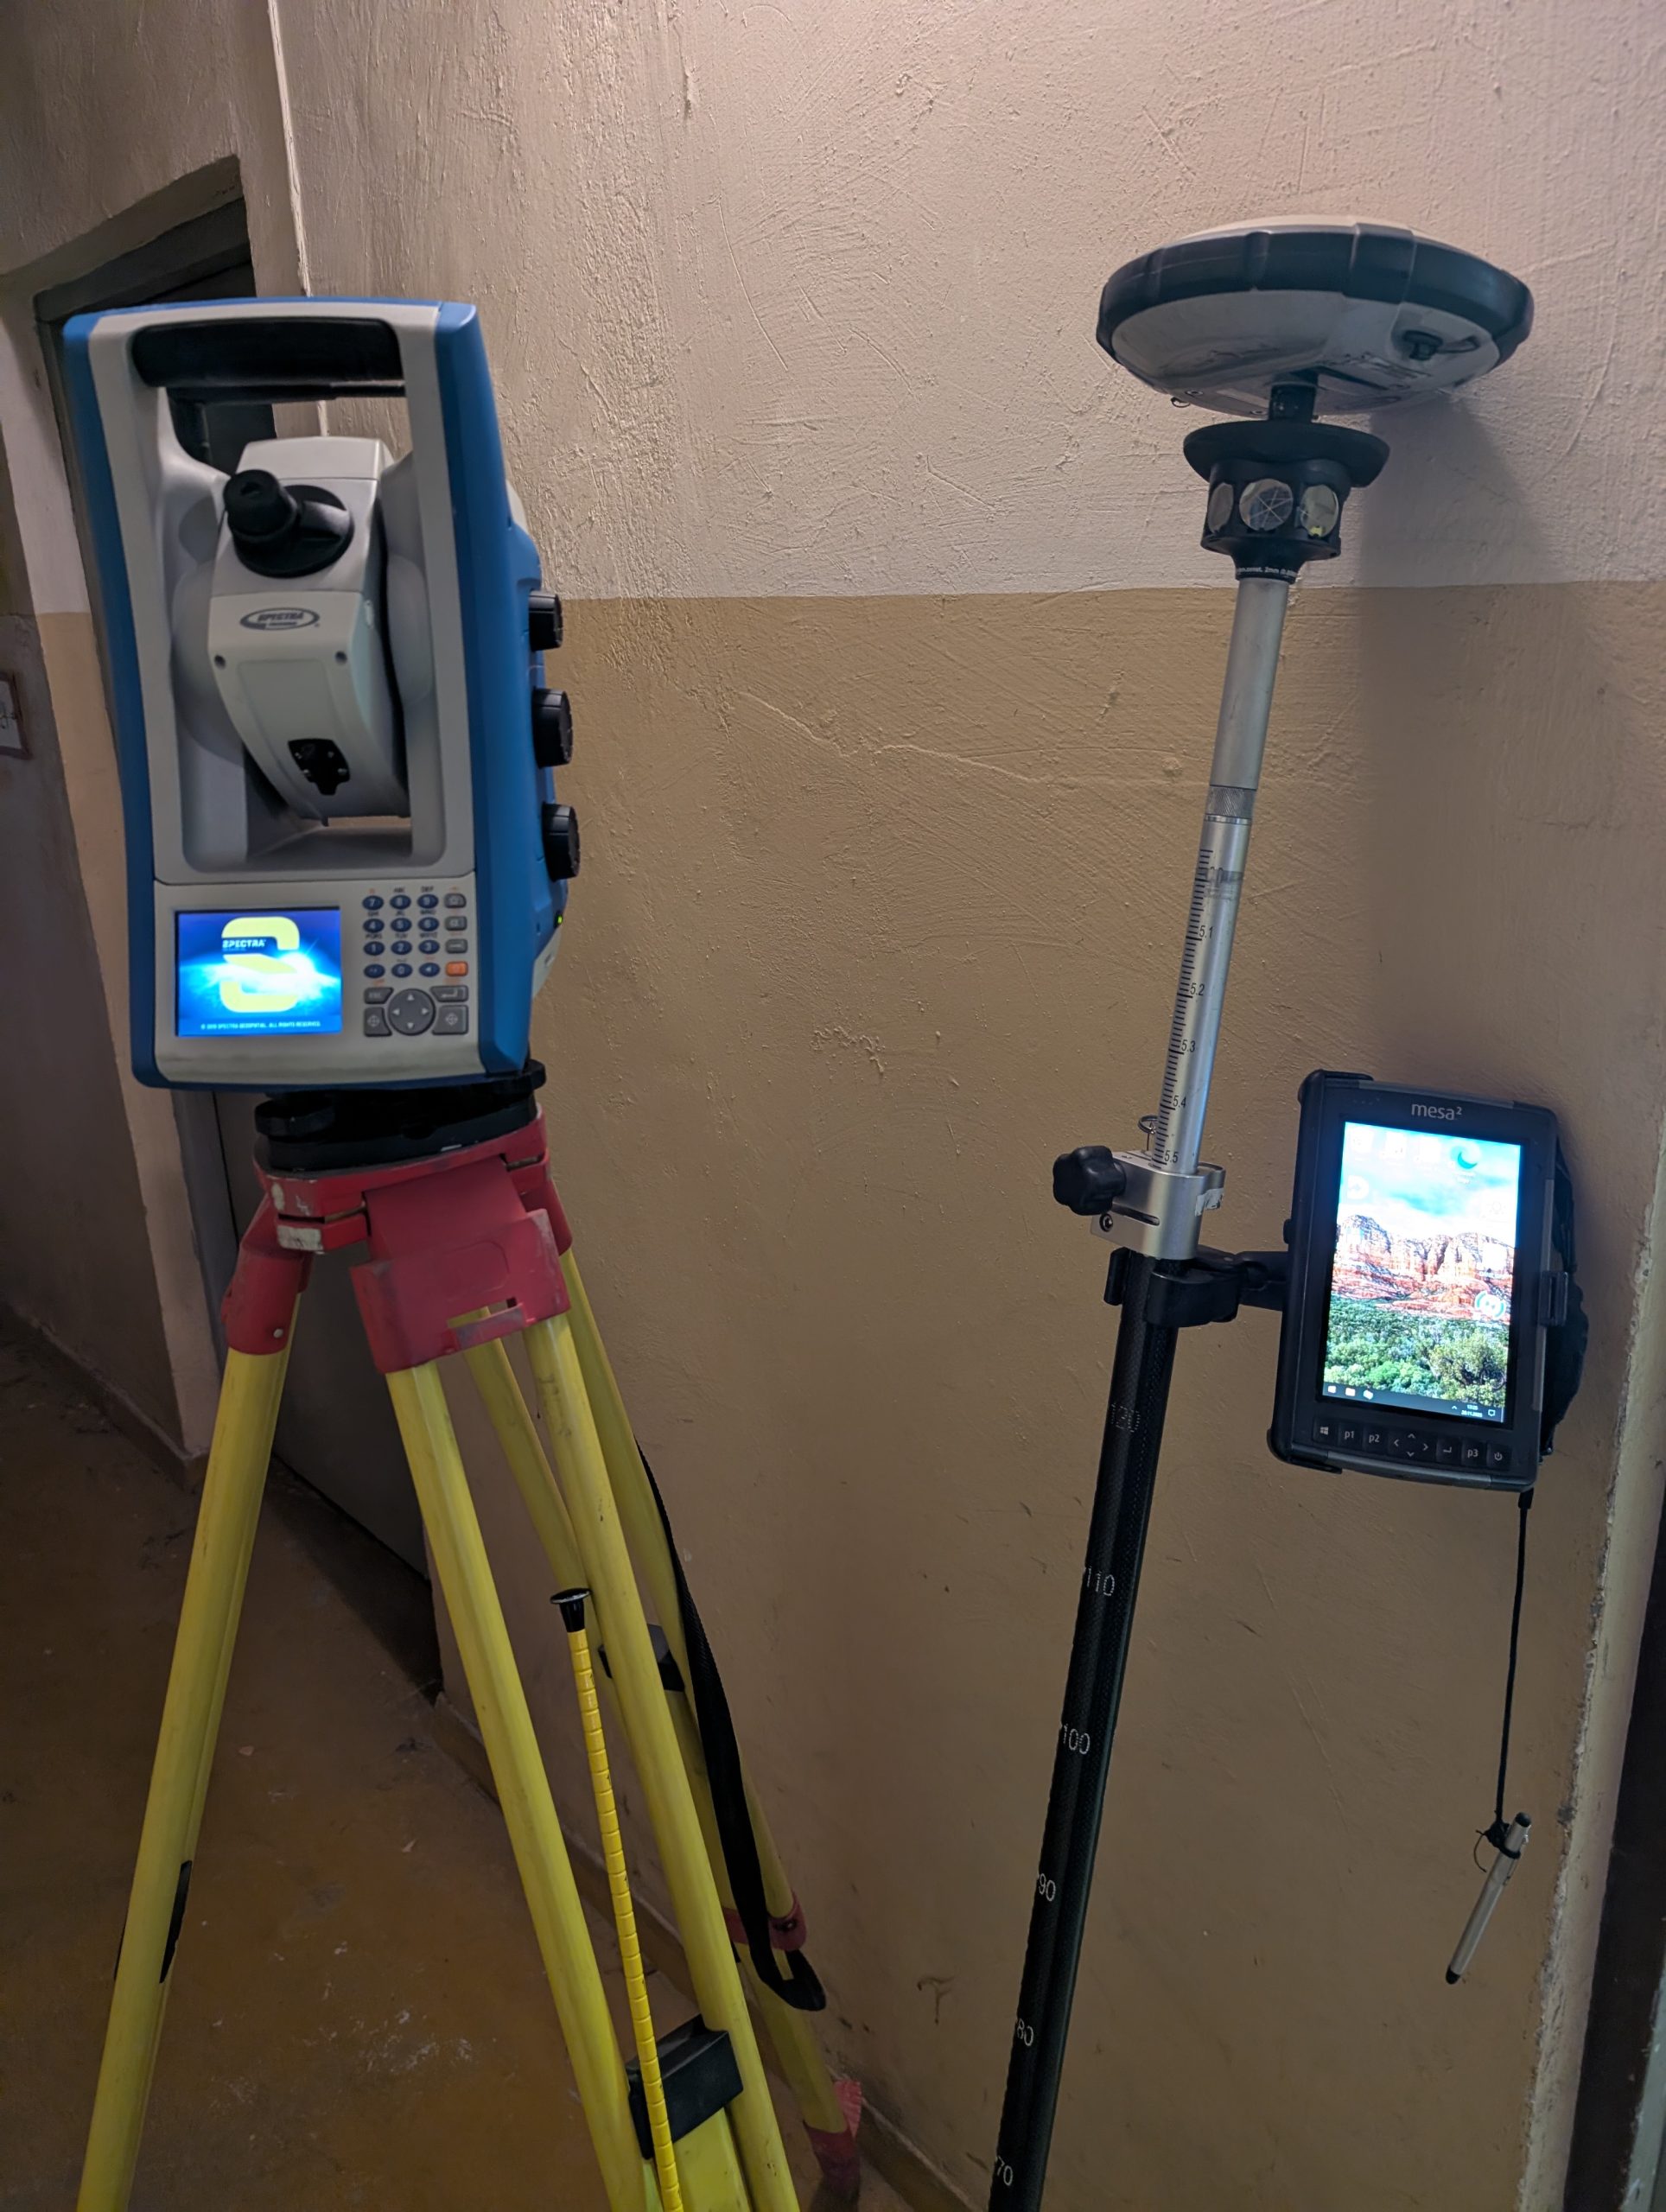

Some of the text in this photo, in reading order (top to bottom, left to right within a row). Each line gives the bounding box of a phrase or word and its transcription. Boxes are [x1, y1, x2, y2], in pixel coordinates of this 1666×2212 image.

[258, 612, 304, 622] SPECTRA
[1199, 925, 1214, 939] 5.1
[222, 939, 265, 948] SPECTRA
[1190, 982, 1205, 996] 5.2
[1181, 1039, 1196, 1052] 5.3
[1173, 1096, 1186, 1109] 5.4
[1165, 1150, 1179, 1164] 5.5
[1344, 1430, 1355, 1440] p1
[1369, 1433, 1380, 1445] p2
[1467, 1448, 1479, 1459] p3
[1086, 1565, 1116, 1597] 110
[1063, 1723, 1091, 1755] 100
[1038, 1872, 1056, 1902] 90
[1016, 2018, 1034, 2046] 80
[995, 2156, 1014, 2186] 70
